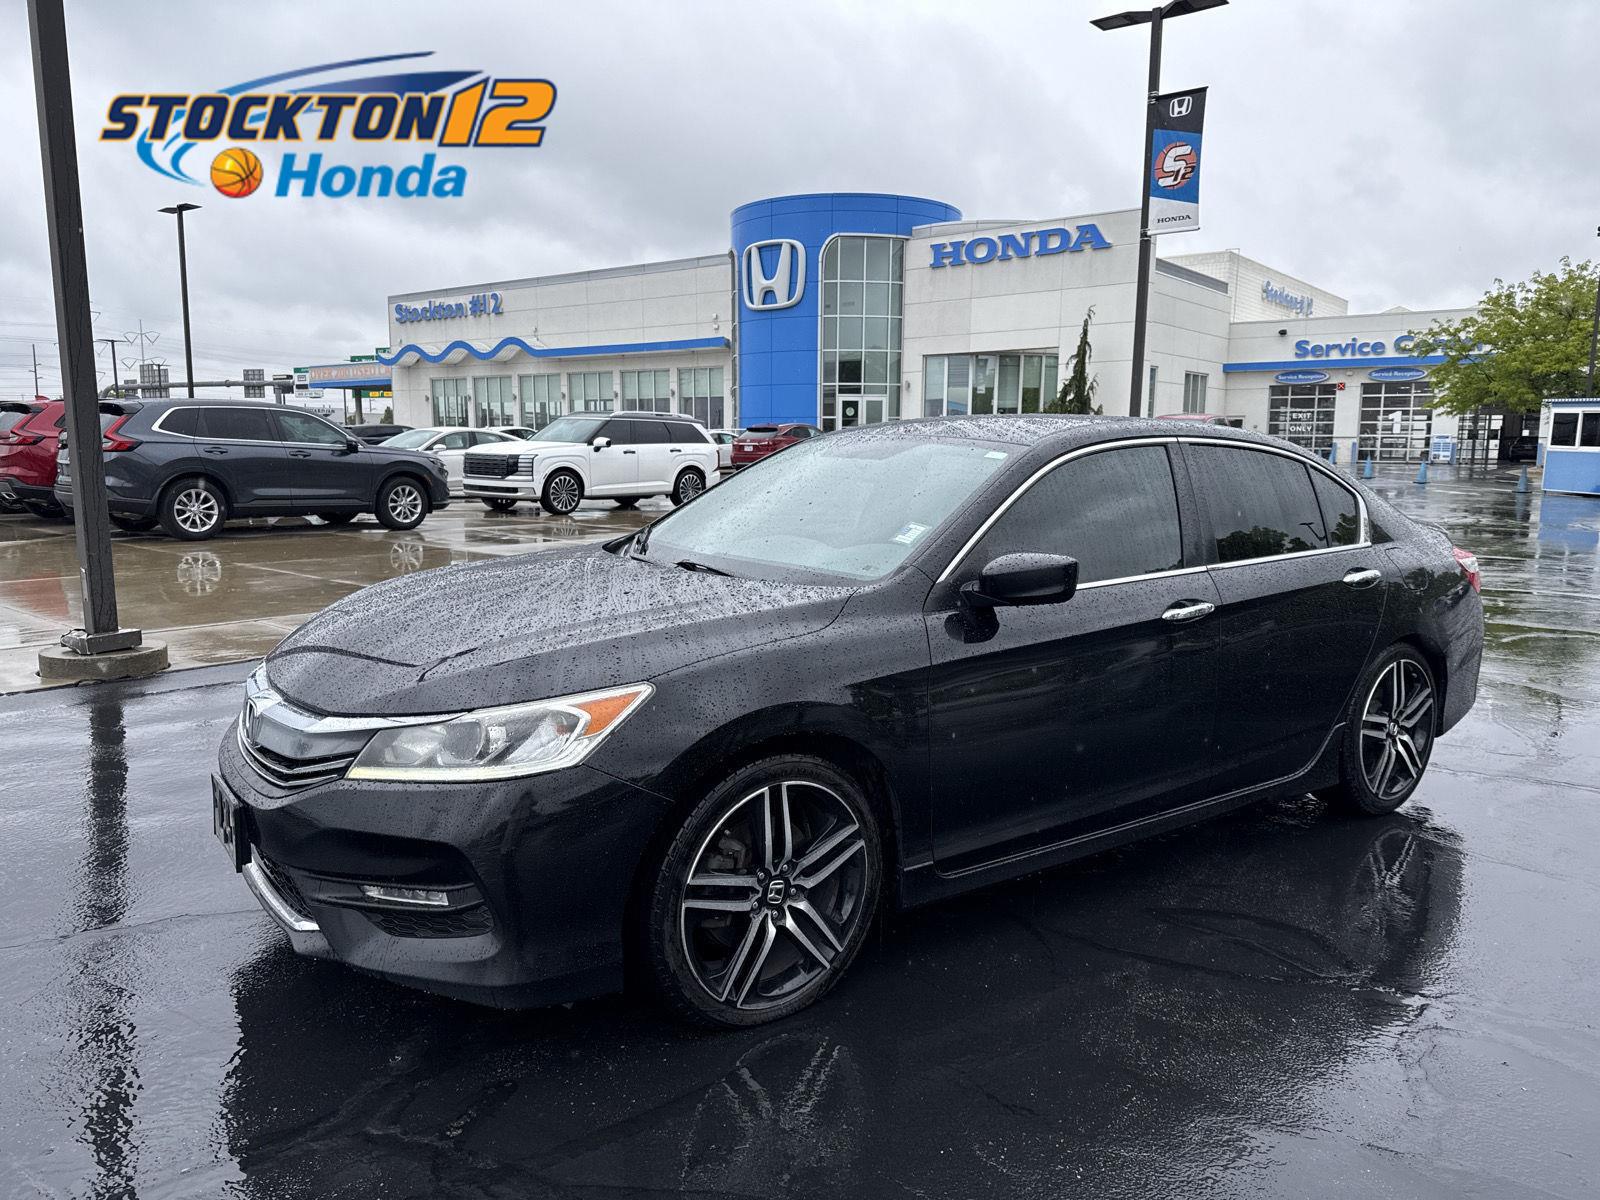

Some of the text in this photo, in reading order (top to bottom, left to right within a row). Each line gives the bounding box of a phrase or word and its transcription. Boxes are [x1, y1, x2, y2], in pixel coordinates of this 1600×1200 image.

[1156, 214, 1192, 224] HONDA
[928, 223, 1112, 269] HONDA
[395, 291, 504, 324] Stockton #12
[1294, 337, 1386, 359] Service
[1388, 410, 1402, 434] 1
